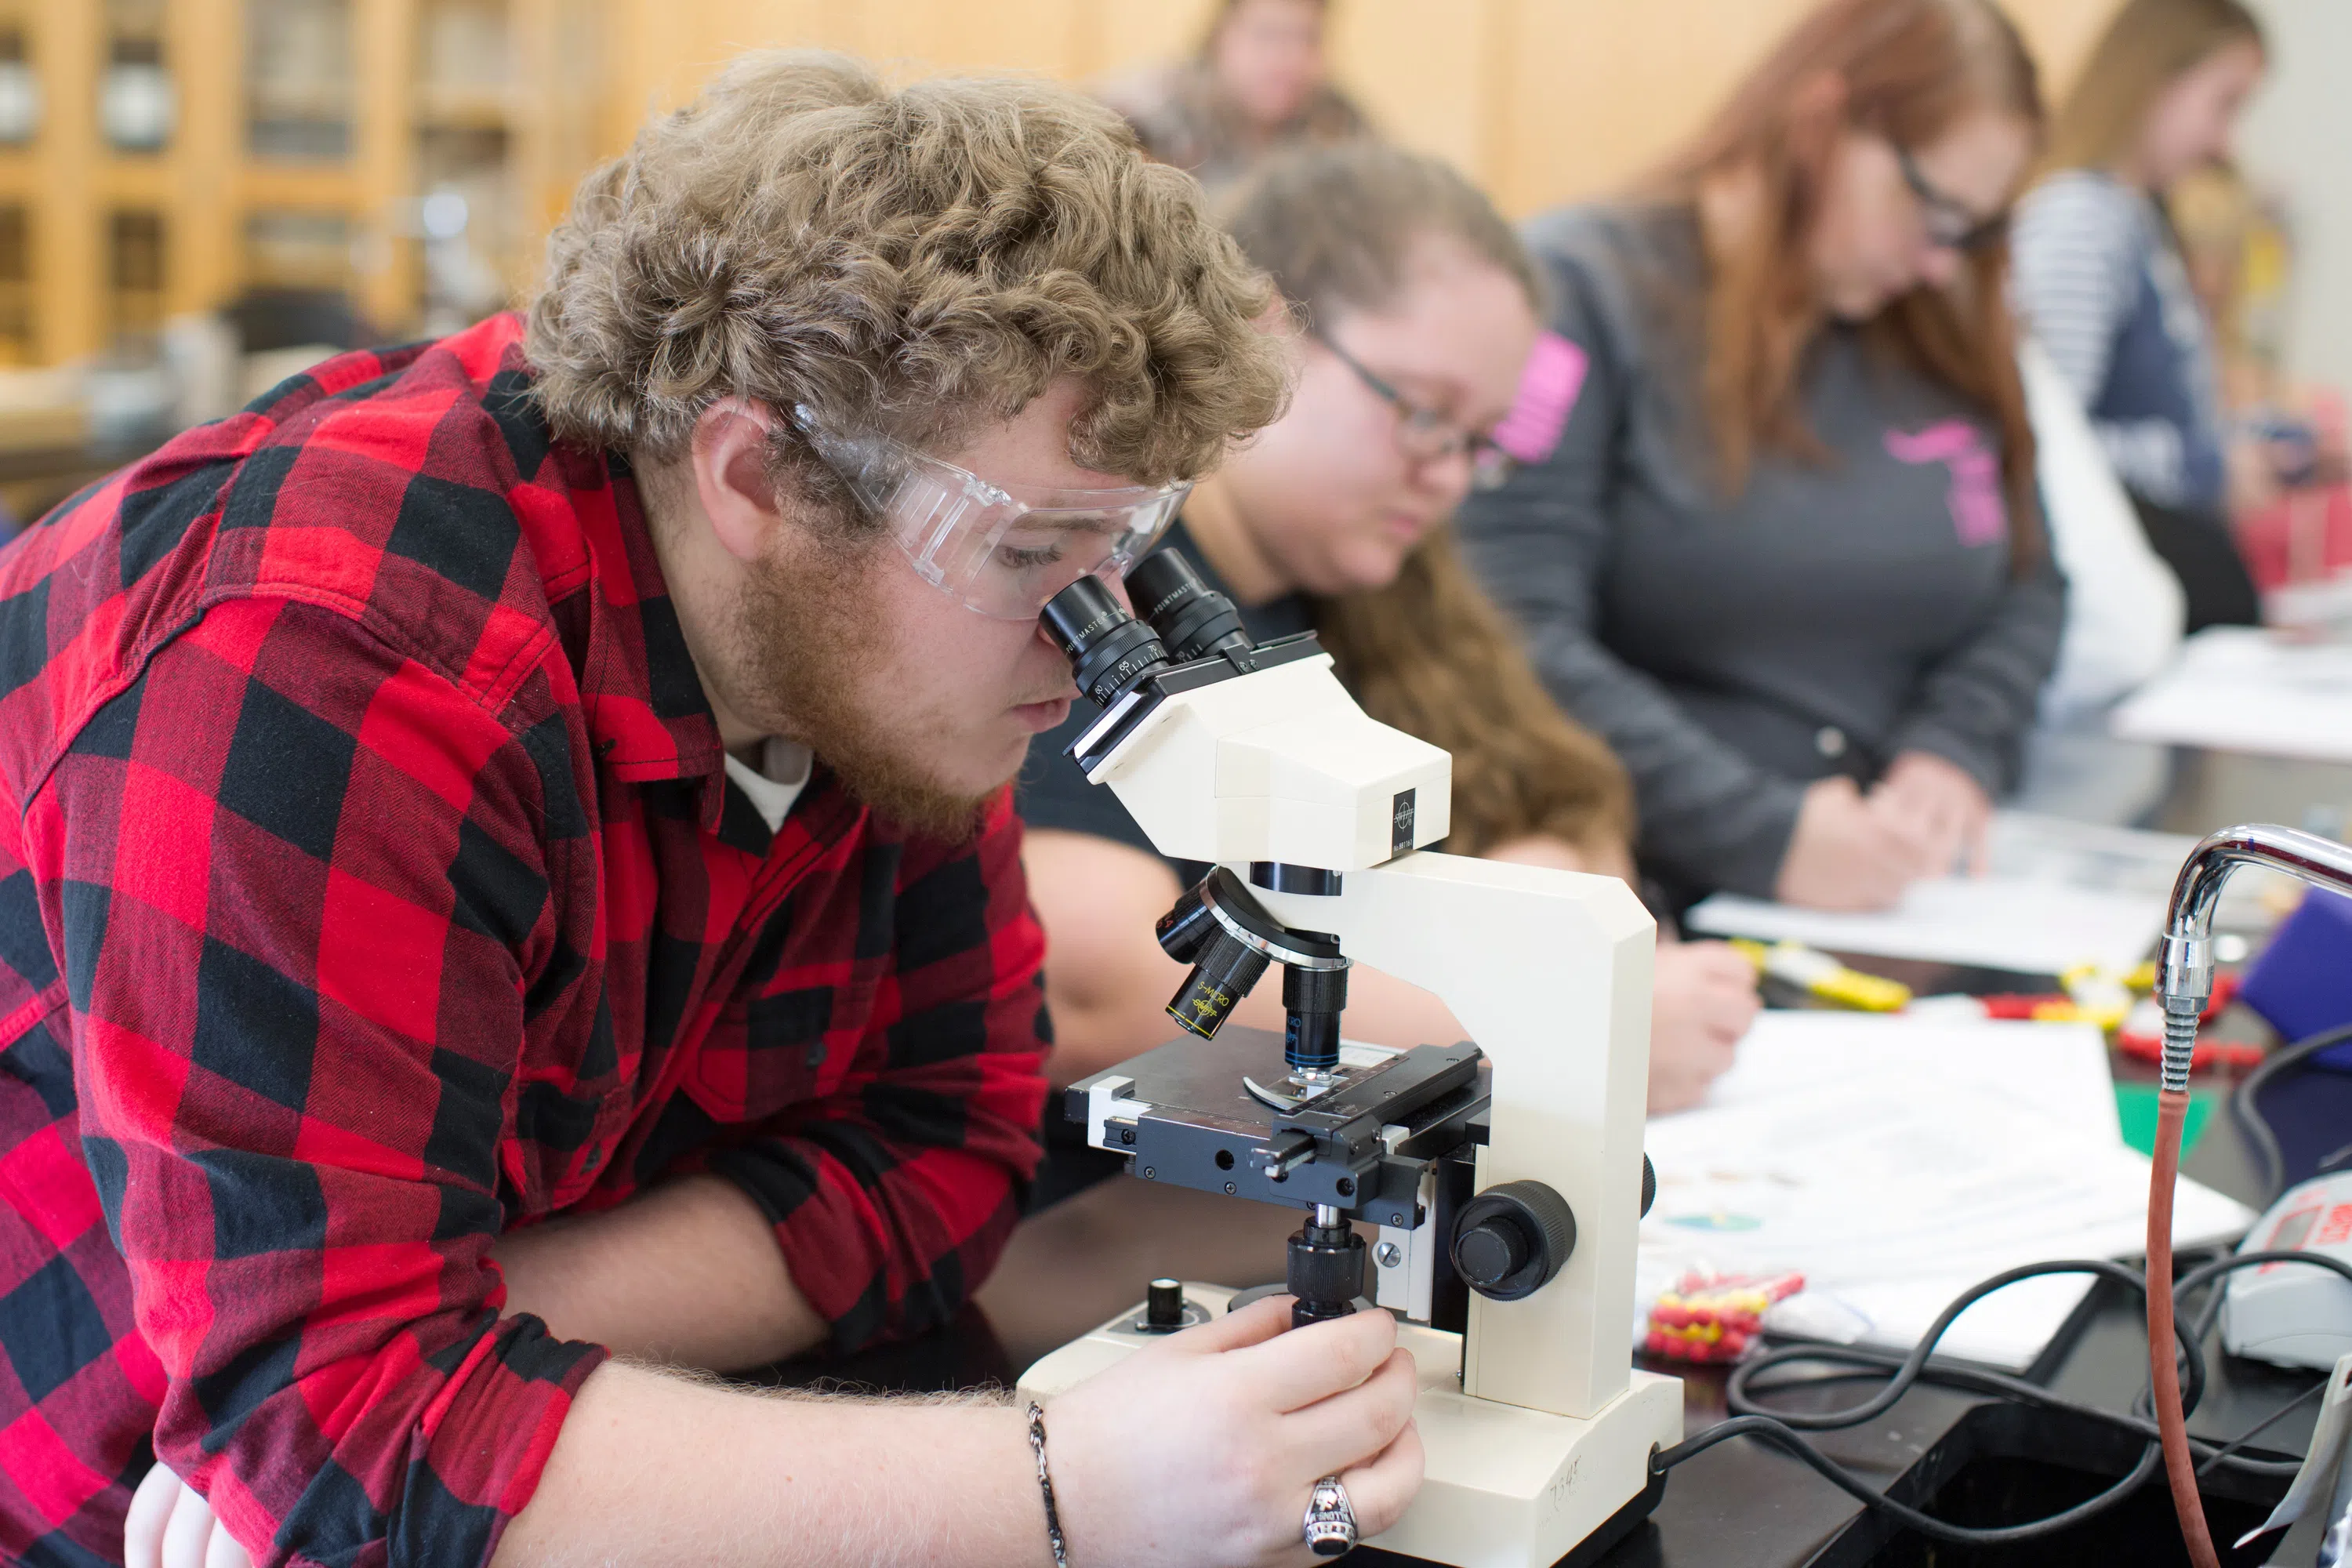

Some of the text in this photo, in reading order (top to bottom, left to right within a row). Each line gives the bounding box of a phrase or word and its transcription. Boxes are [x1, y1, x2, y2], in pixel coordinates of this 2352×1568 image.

[1118, 660, 1130, 671] 65
[1094, 684, 1104, 695] 60
[1197, 981, 1229, 1007] S-MICRO
